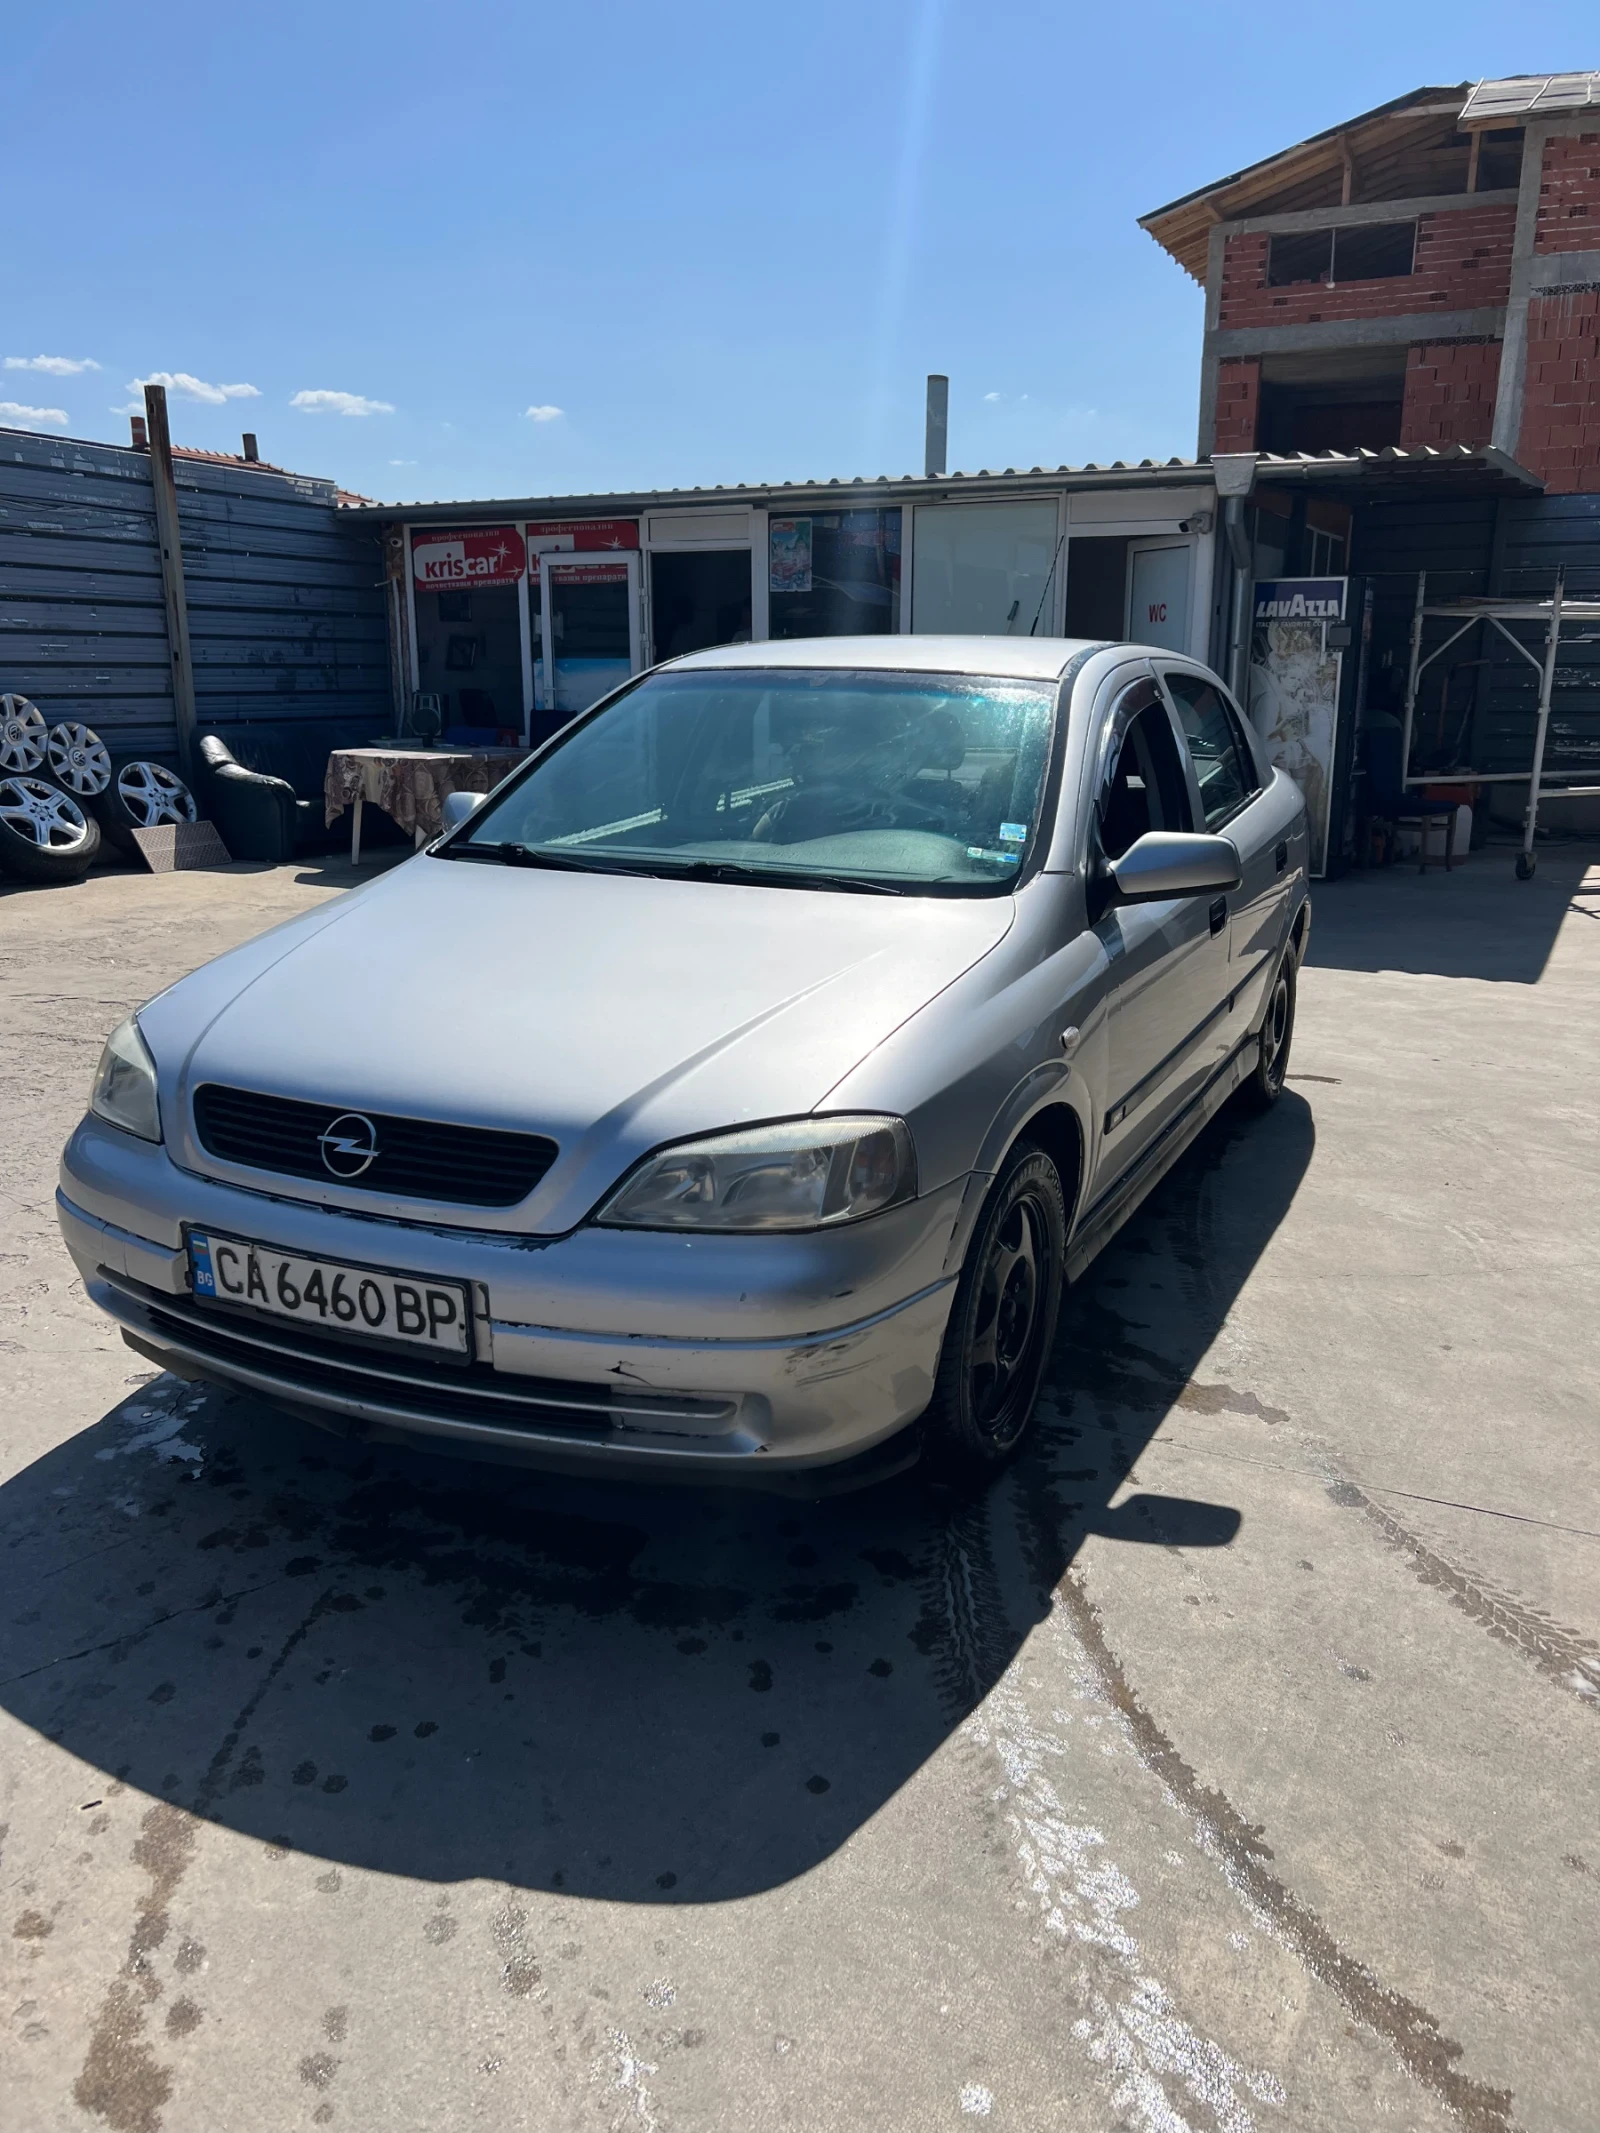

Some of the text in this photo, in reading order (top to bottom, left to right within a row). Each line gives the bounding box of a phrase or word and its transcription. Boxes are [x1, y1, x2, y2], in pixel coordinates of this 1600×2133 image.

[1149, 603, 1167, 622] WC
[1256, 594, 1340, 618] LAVAZZA
[197, 1269, 213, 1287] BG
